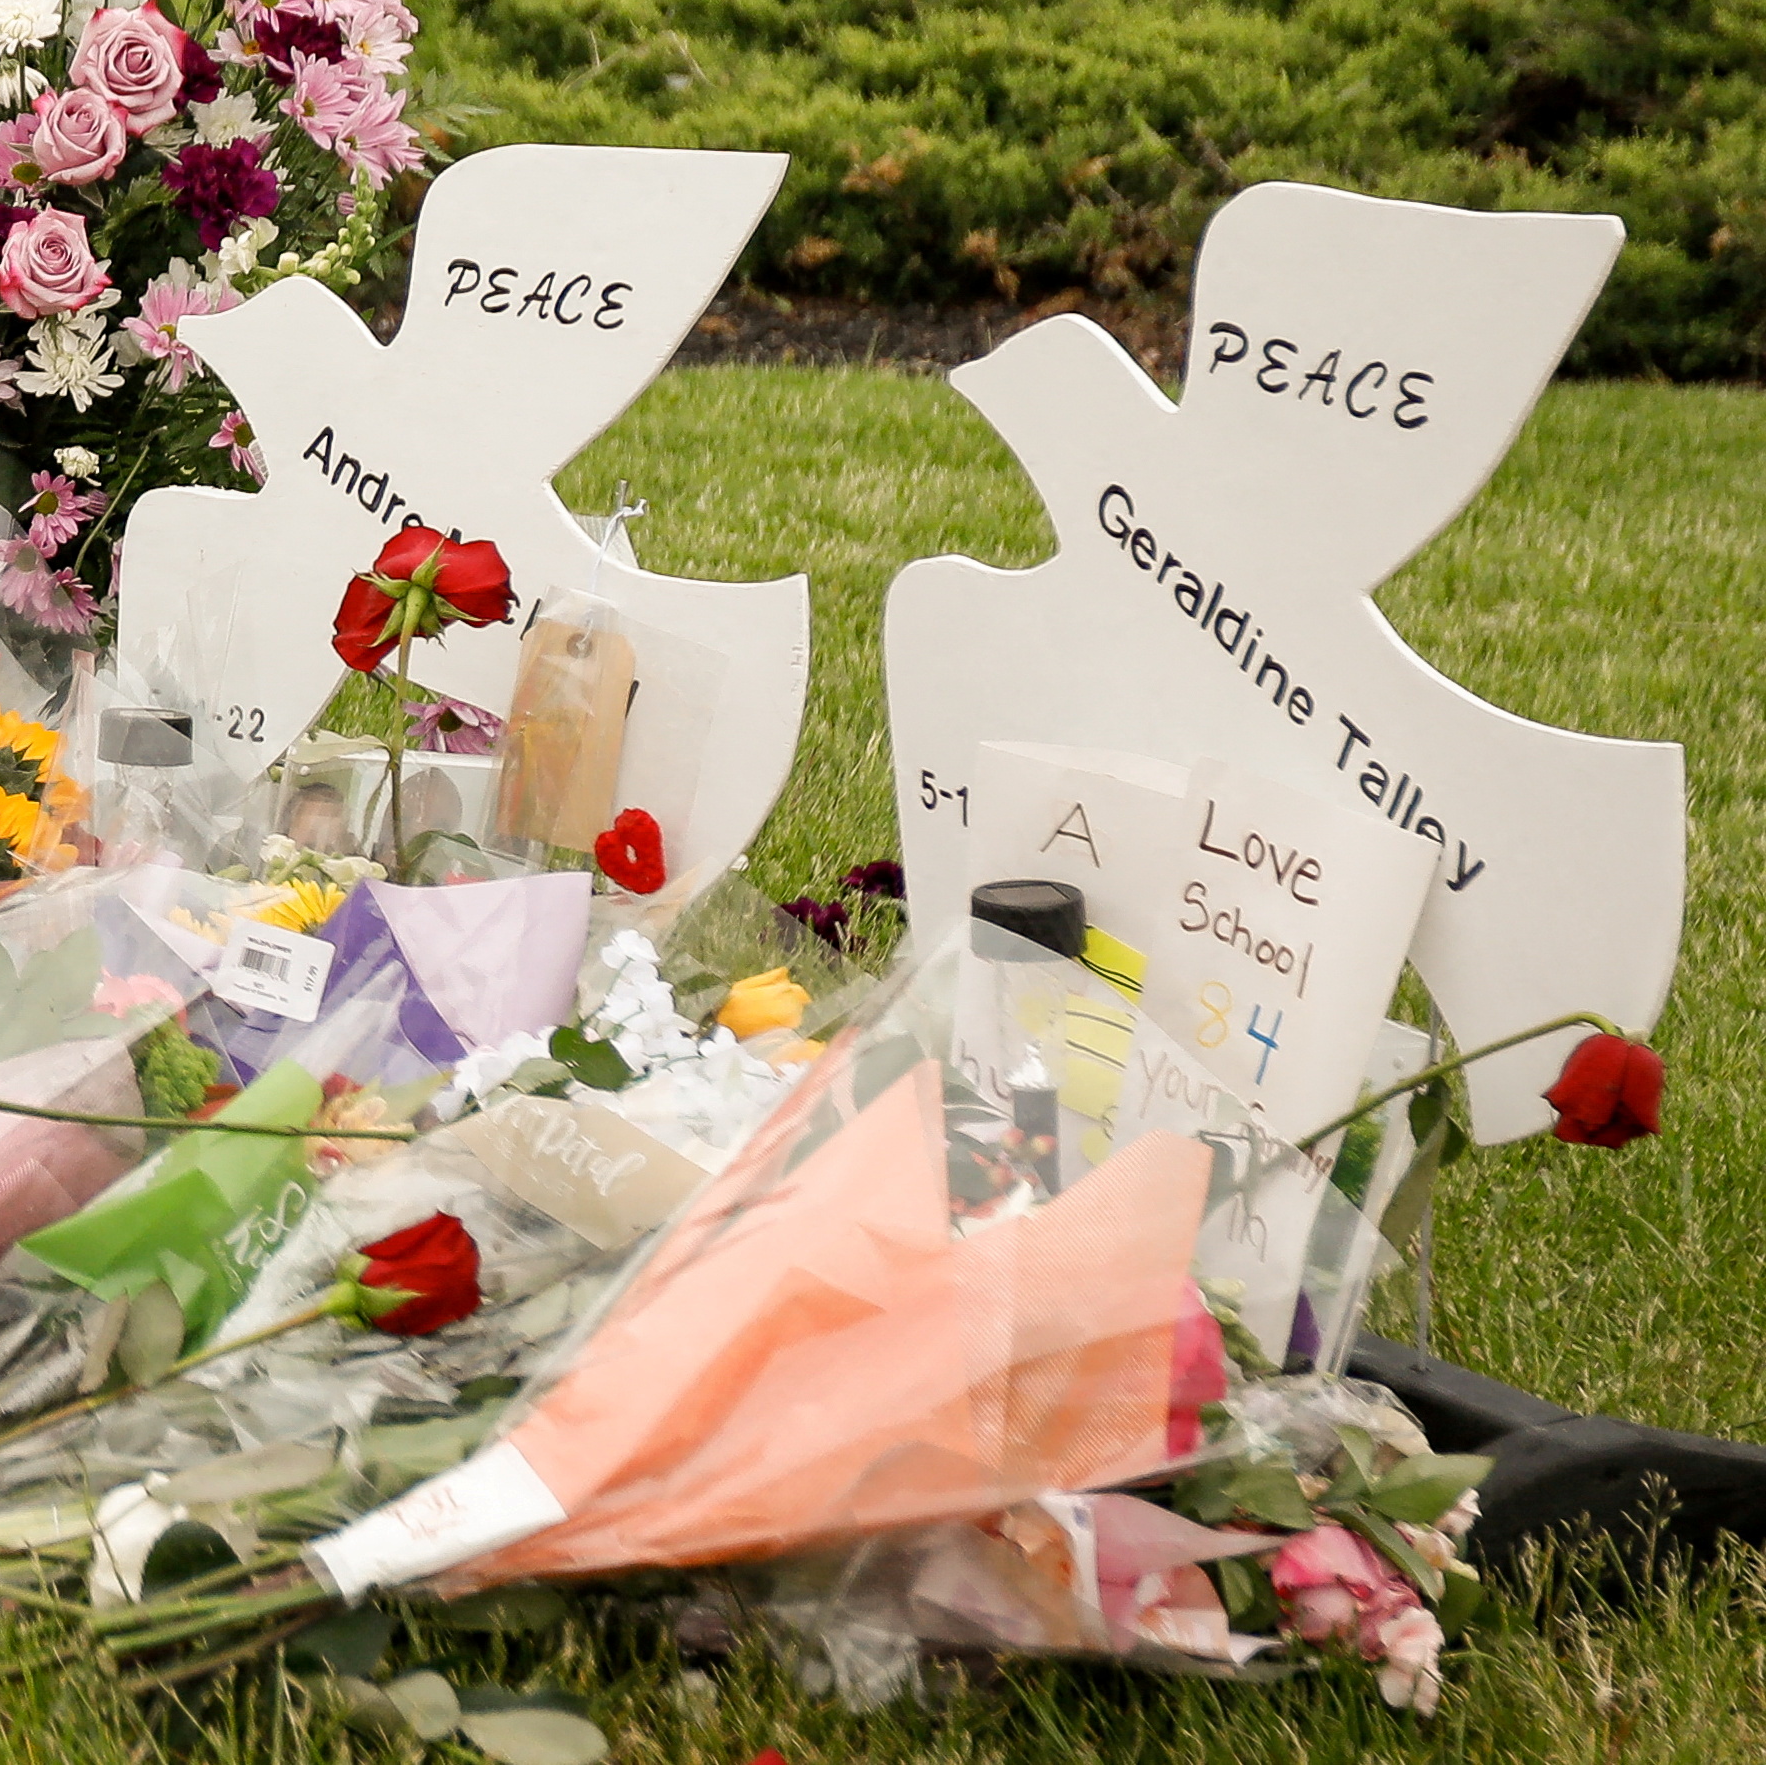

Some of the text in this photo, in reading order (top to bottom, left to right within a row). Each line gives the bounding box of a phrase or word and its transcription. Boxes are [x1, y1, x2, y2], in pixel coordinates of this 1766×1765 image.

[443, 257, 634, 330] PEACE
[1207, 321, 1436, 431] PEACE
[1097, 483, 1486, 892] Geraldine Talley
[919, 768, 969, 828] 5-1
[1039, 799, 1322, 907] A Love
[1179, 880, 1315, 1000] School
[1195, 980, 1284, 1086] 84
